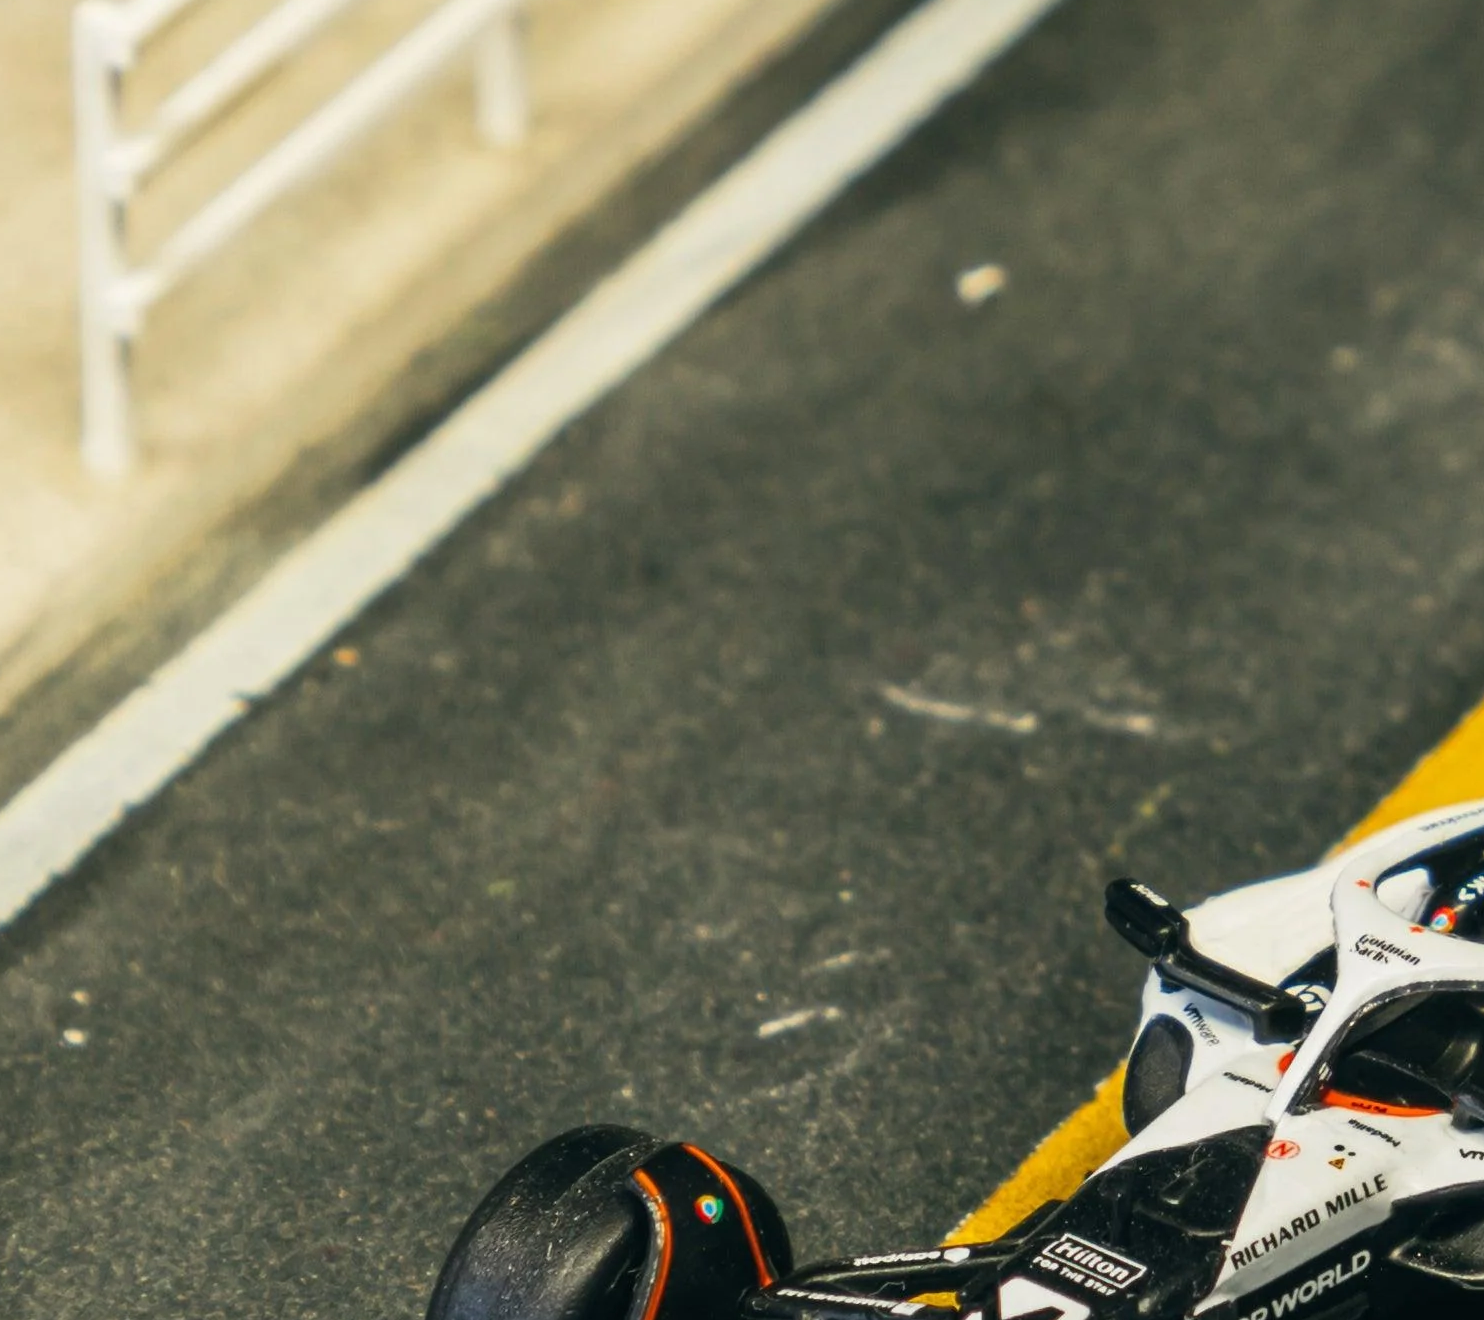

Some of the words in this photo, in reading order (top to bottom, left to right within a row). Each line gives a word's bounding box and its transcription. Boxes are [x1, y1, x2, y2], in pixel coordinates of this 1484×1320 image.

[1230, 1208, 1321, 1272] RICHARD
[1324, 1173, 1389, 1219] MILLE
[1054, 1242, 1130, 1282] Hilton
[1270, 1249, 1371, 1319] WORLD
